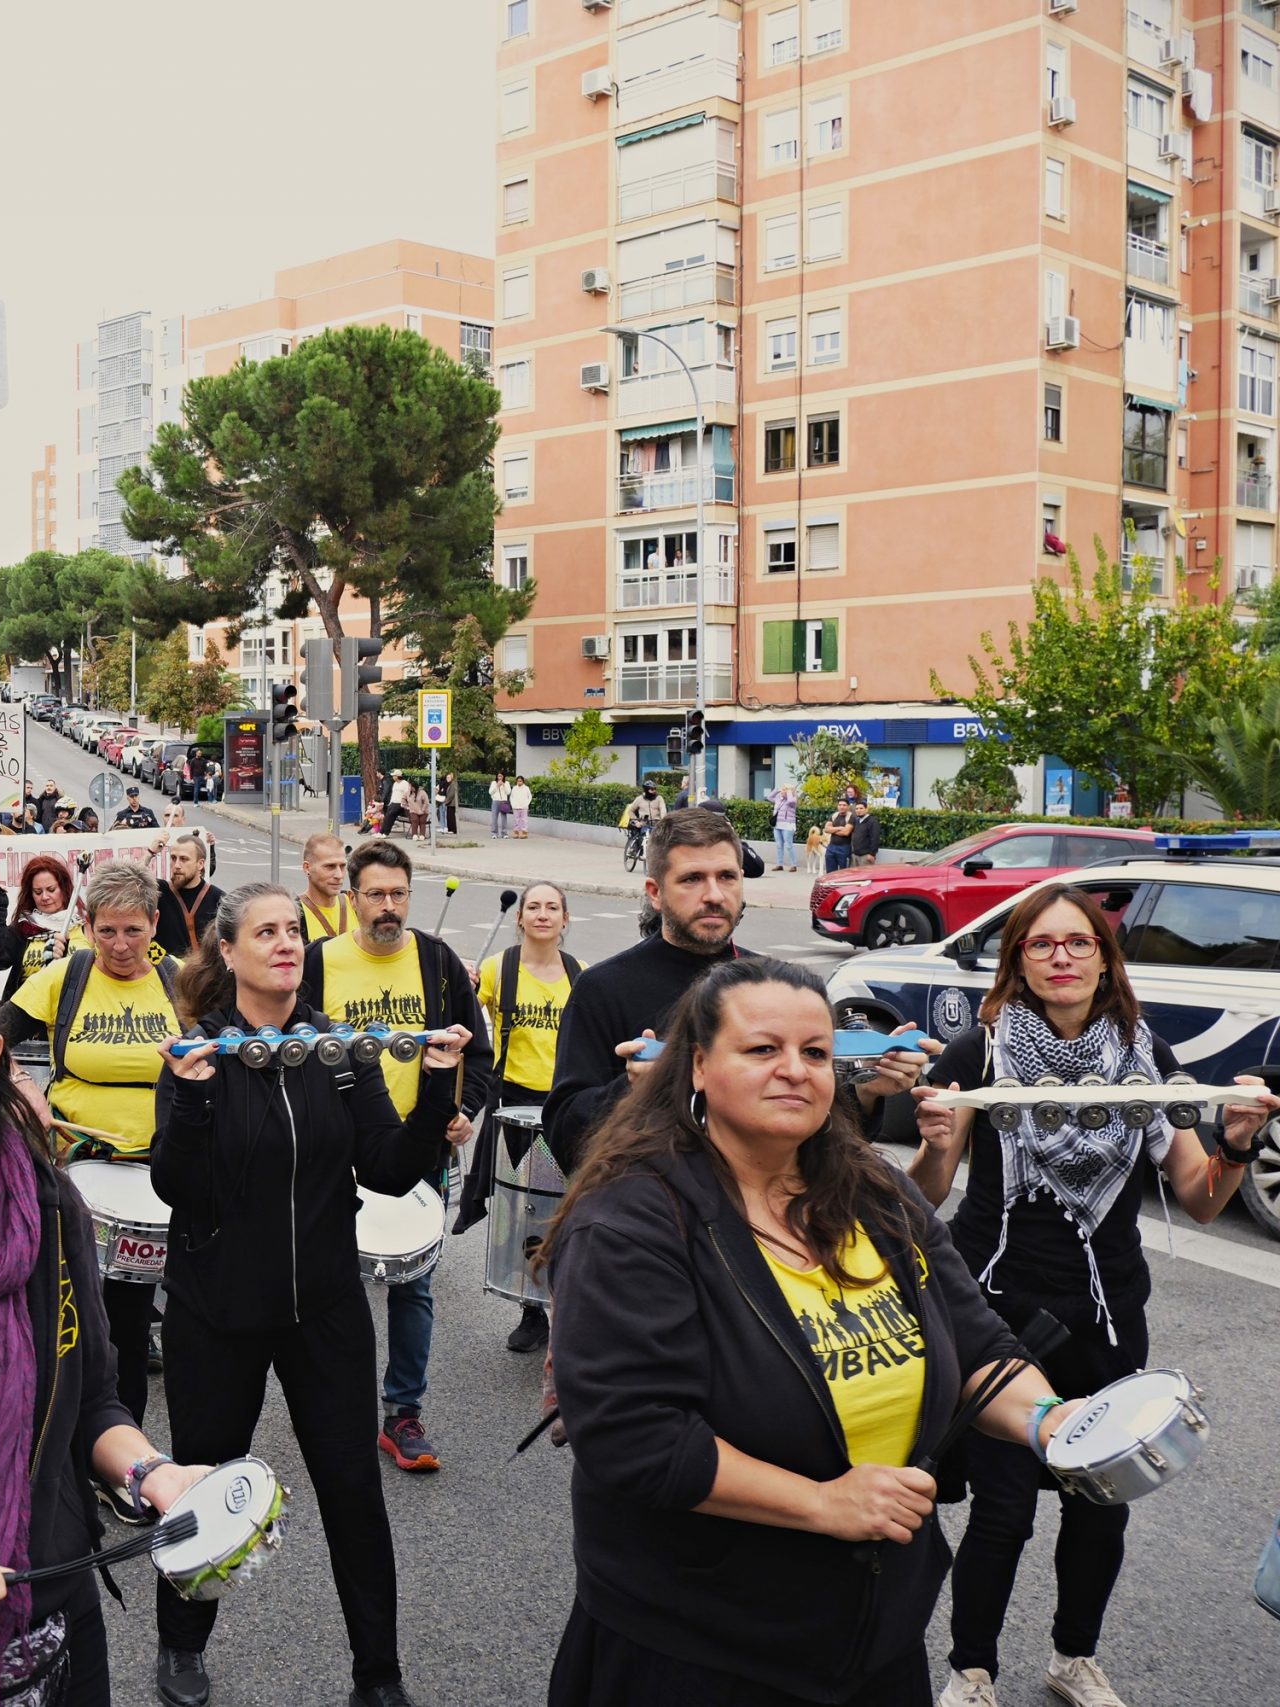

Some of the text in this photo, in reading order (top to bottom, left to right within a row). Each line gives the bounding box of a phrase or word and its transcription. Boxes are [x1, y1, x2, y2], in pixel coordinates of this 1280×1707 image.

[542, 728, 569, 742] BBV
[342, 1012, 425, 1030] AMBALEZ
[68, 1030, 175, 1045] SAMBALEZ
[116, 1253, 165, 1266] PRECARIEDAD
[815, 1329, 925, 1381] MBALE
